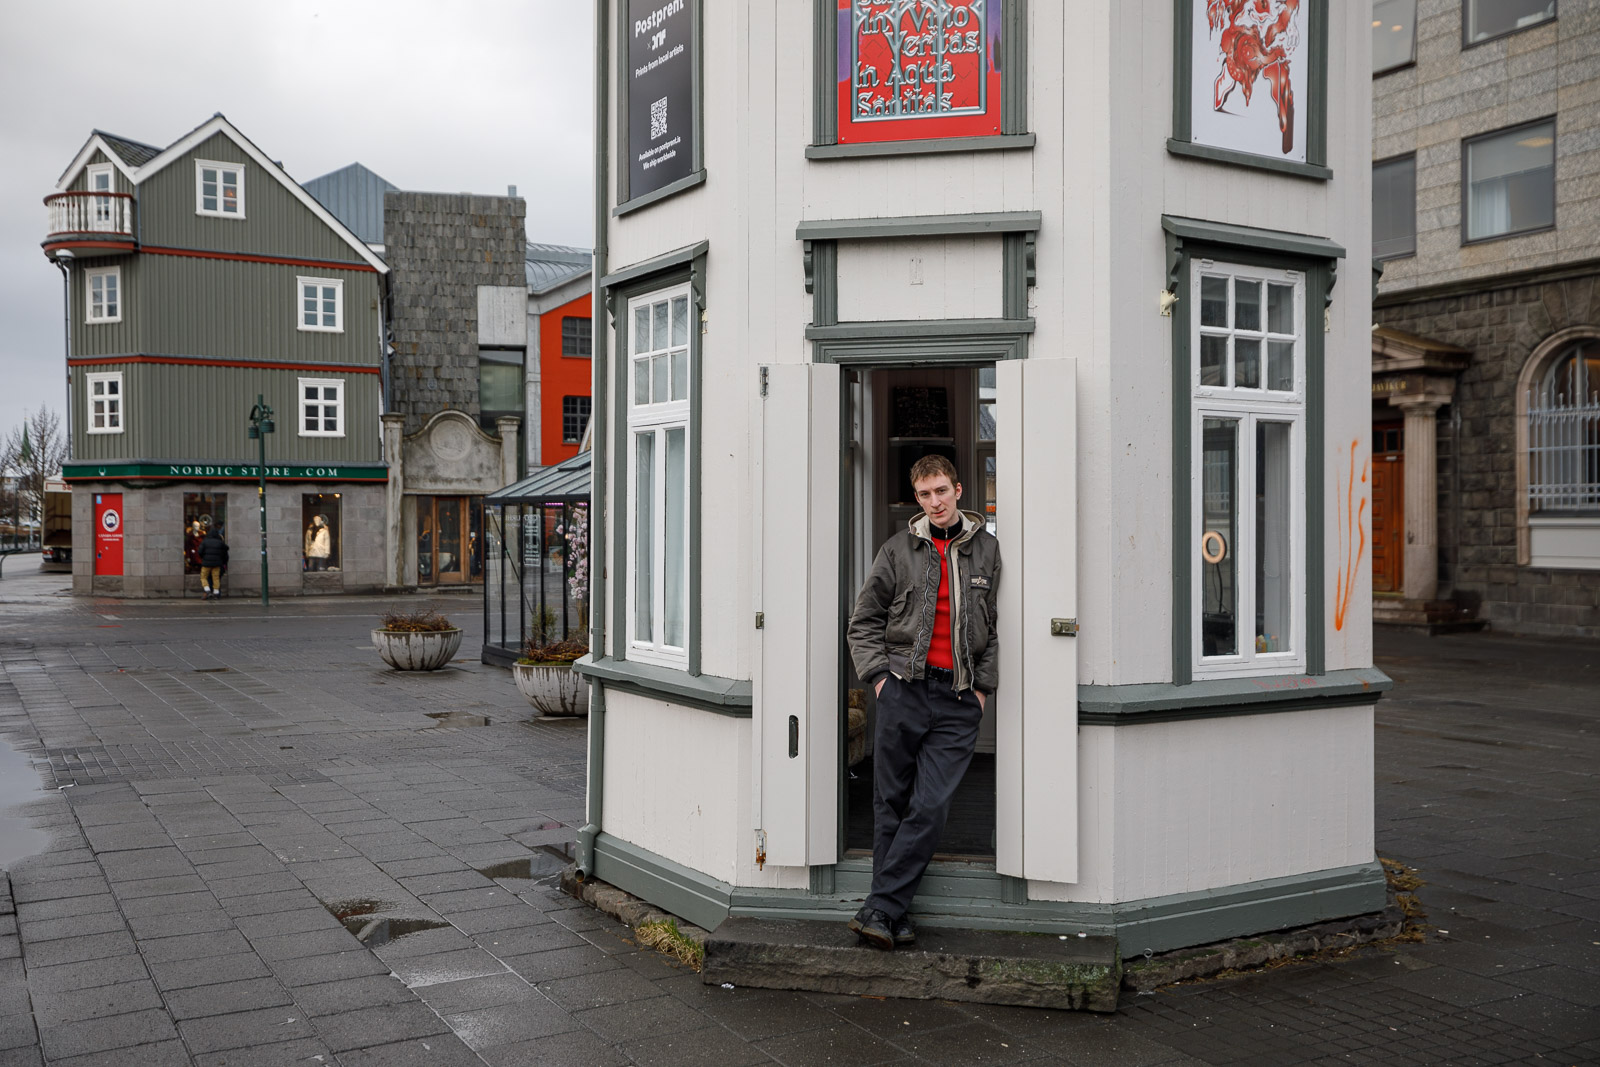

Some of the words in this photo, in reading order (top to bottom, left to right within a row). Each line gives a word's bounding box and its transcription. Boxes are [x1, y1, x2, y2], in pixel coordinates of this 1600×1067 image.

[635, 0, 684, 38] Postprent
[635, 65, 648, 78] Prints
[648, 61, 658, 71] from
[658, 51, 669, 64] local
[669, 44, 684, 58] artists
[857, 88, 954, 117] Sanitas
[638, 149, 655, 161] Available
[657, 150, 676, 163] worldwide
[170, 466, 233, 475] NORDIC
[241, 467, 290, 476] STORE
